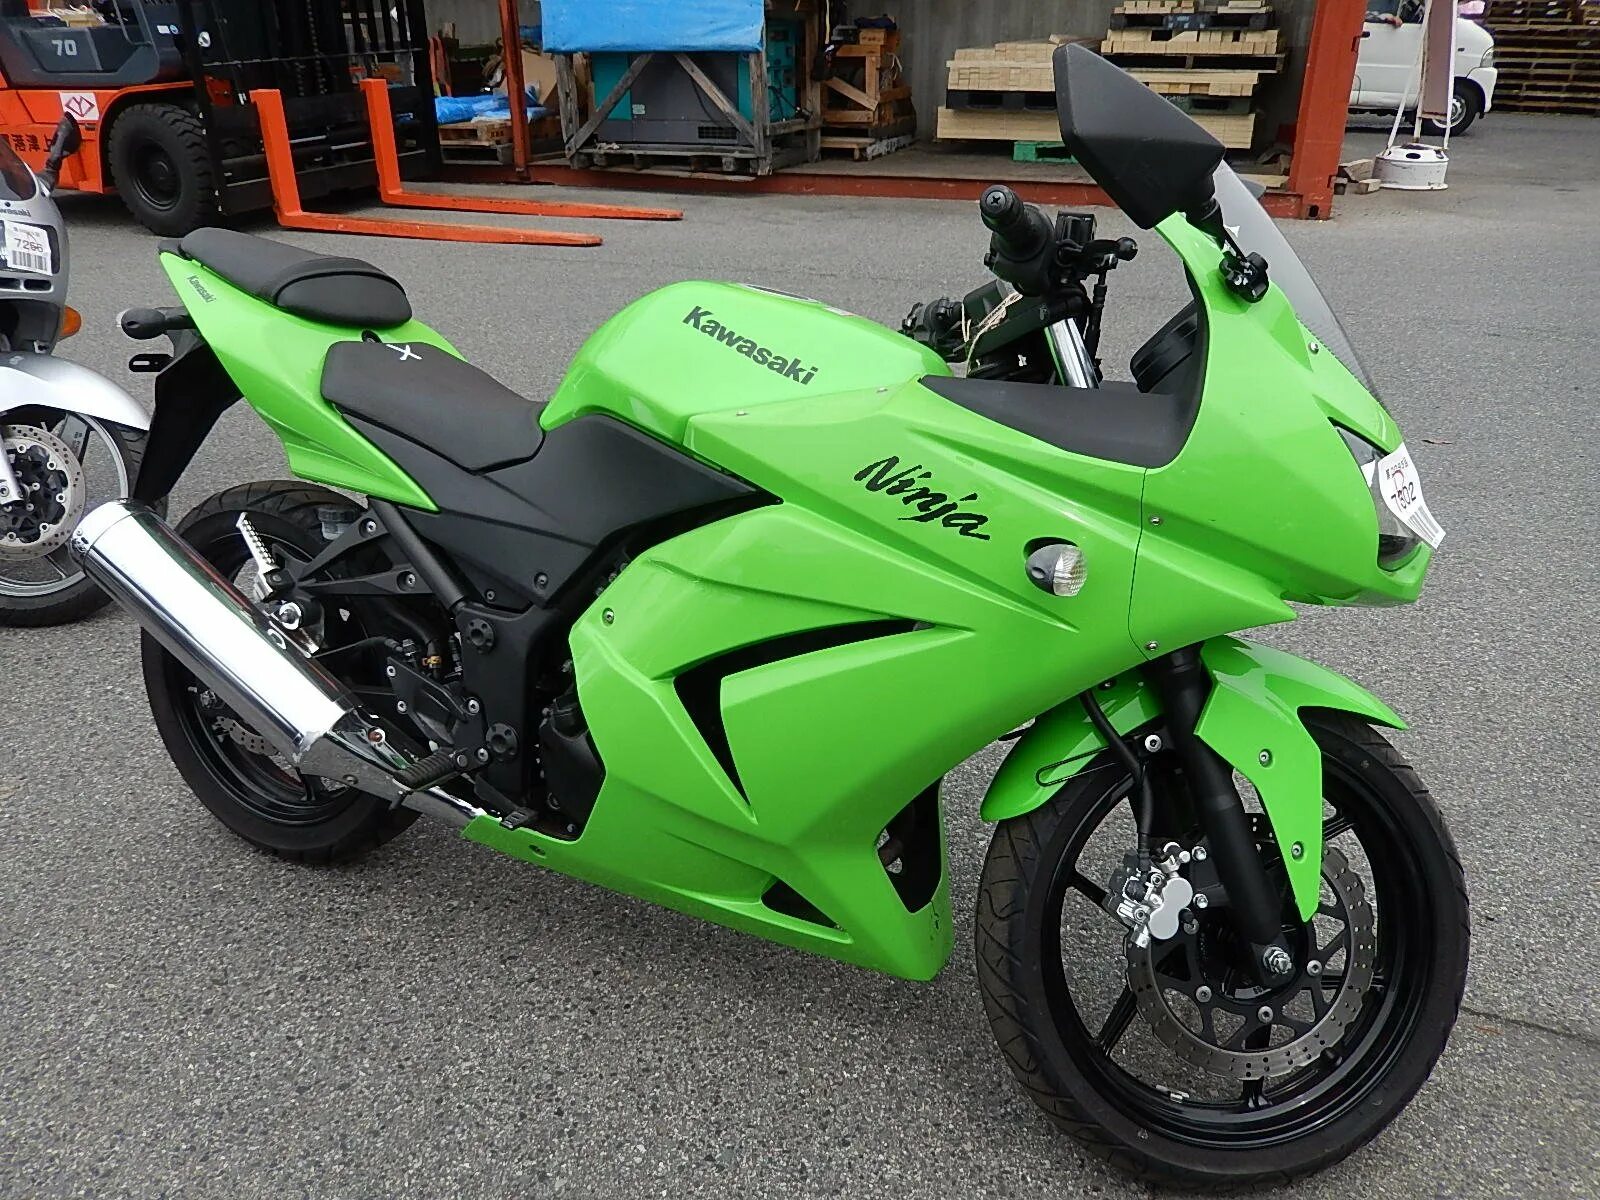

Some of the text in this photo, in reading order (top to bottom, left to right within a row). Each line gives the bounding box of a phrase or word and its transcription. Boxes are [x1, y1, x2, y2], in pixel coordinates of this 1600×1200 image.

[51, 40, 77, 56] 70
[187, 275, 216, 303] Kawasaki
[683, 306, 819, 384] Kawasaki
[854, 455, 991, 541] Ninja
